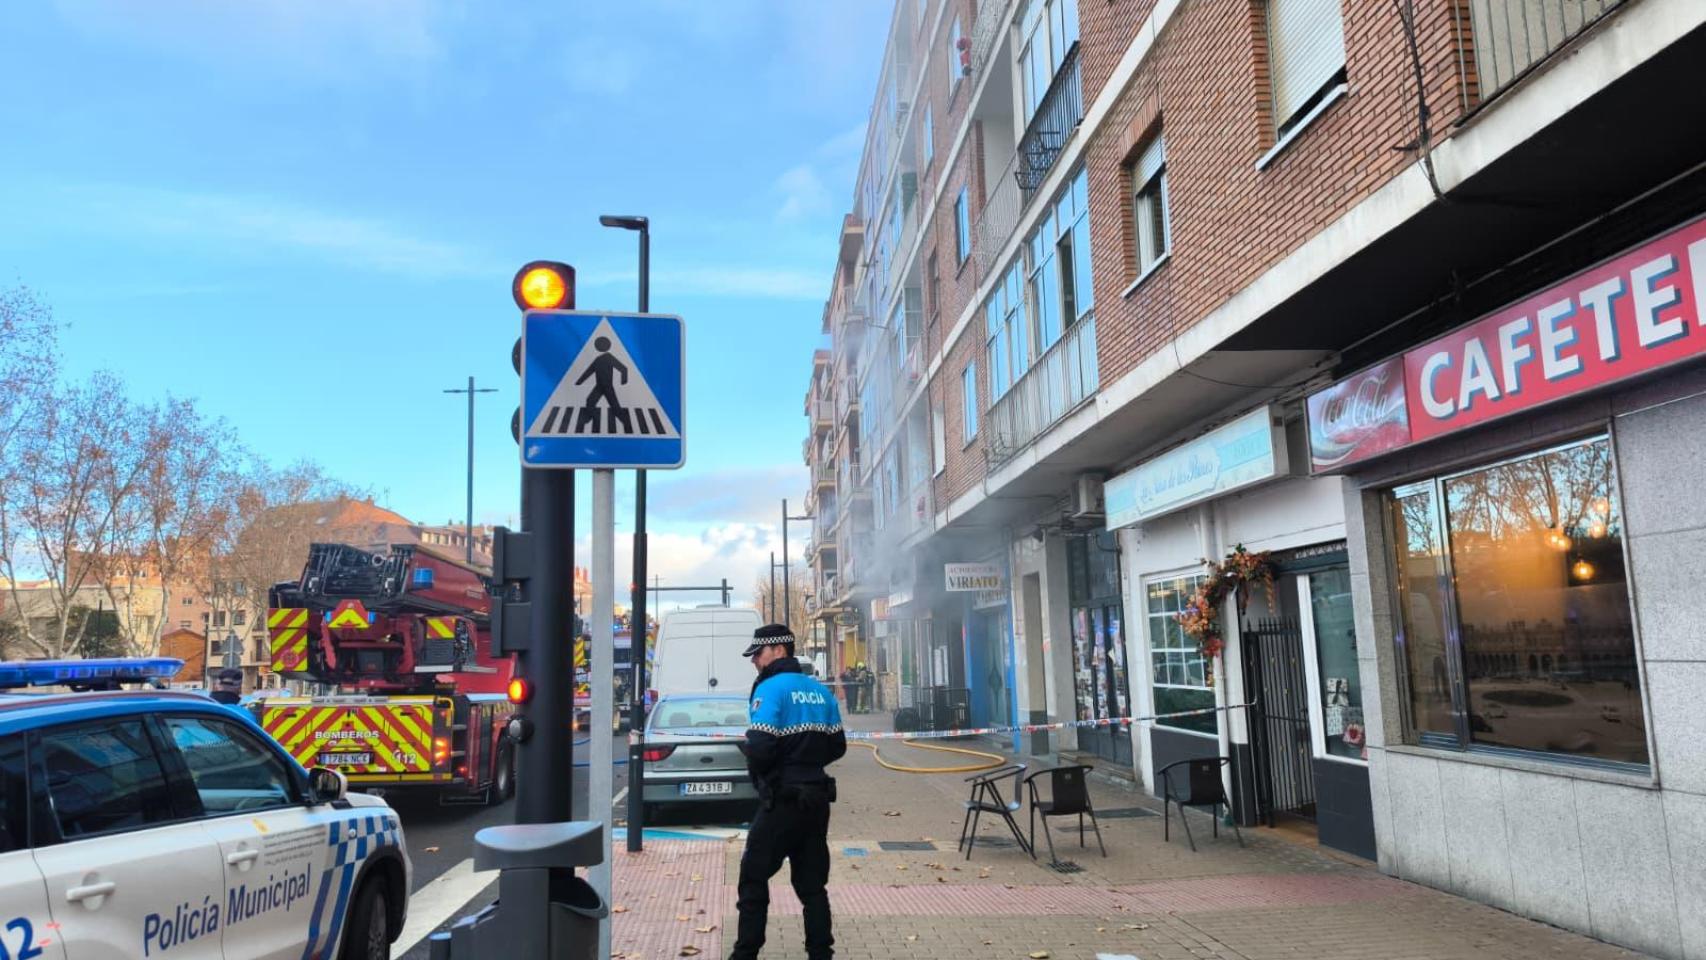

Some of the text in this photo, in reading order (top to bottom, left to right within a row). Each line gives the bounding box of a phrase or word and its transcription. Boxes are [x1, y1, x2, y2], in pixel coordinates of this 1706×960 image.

[949, 575, 999, 589] VIRIATO
[315, 730, 379, 739] BOMBEROS
[143, 863, 312, 957] Policía Municipal
